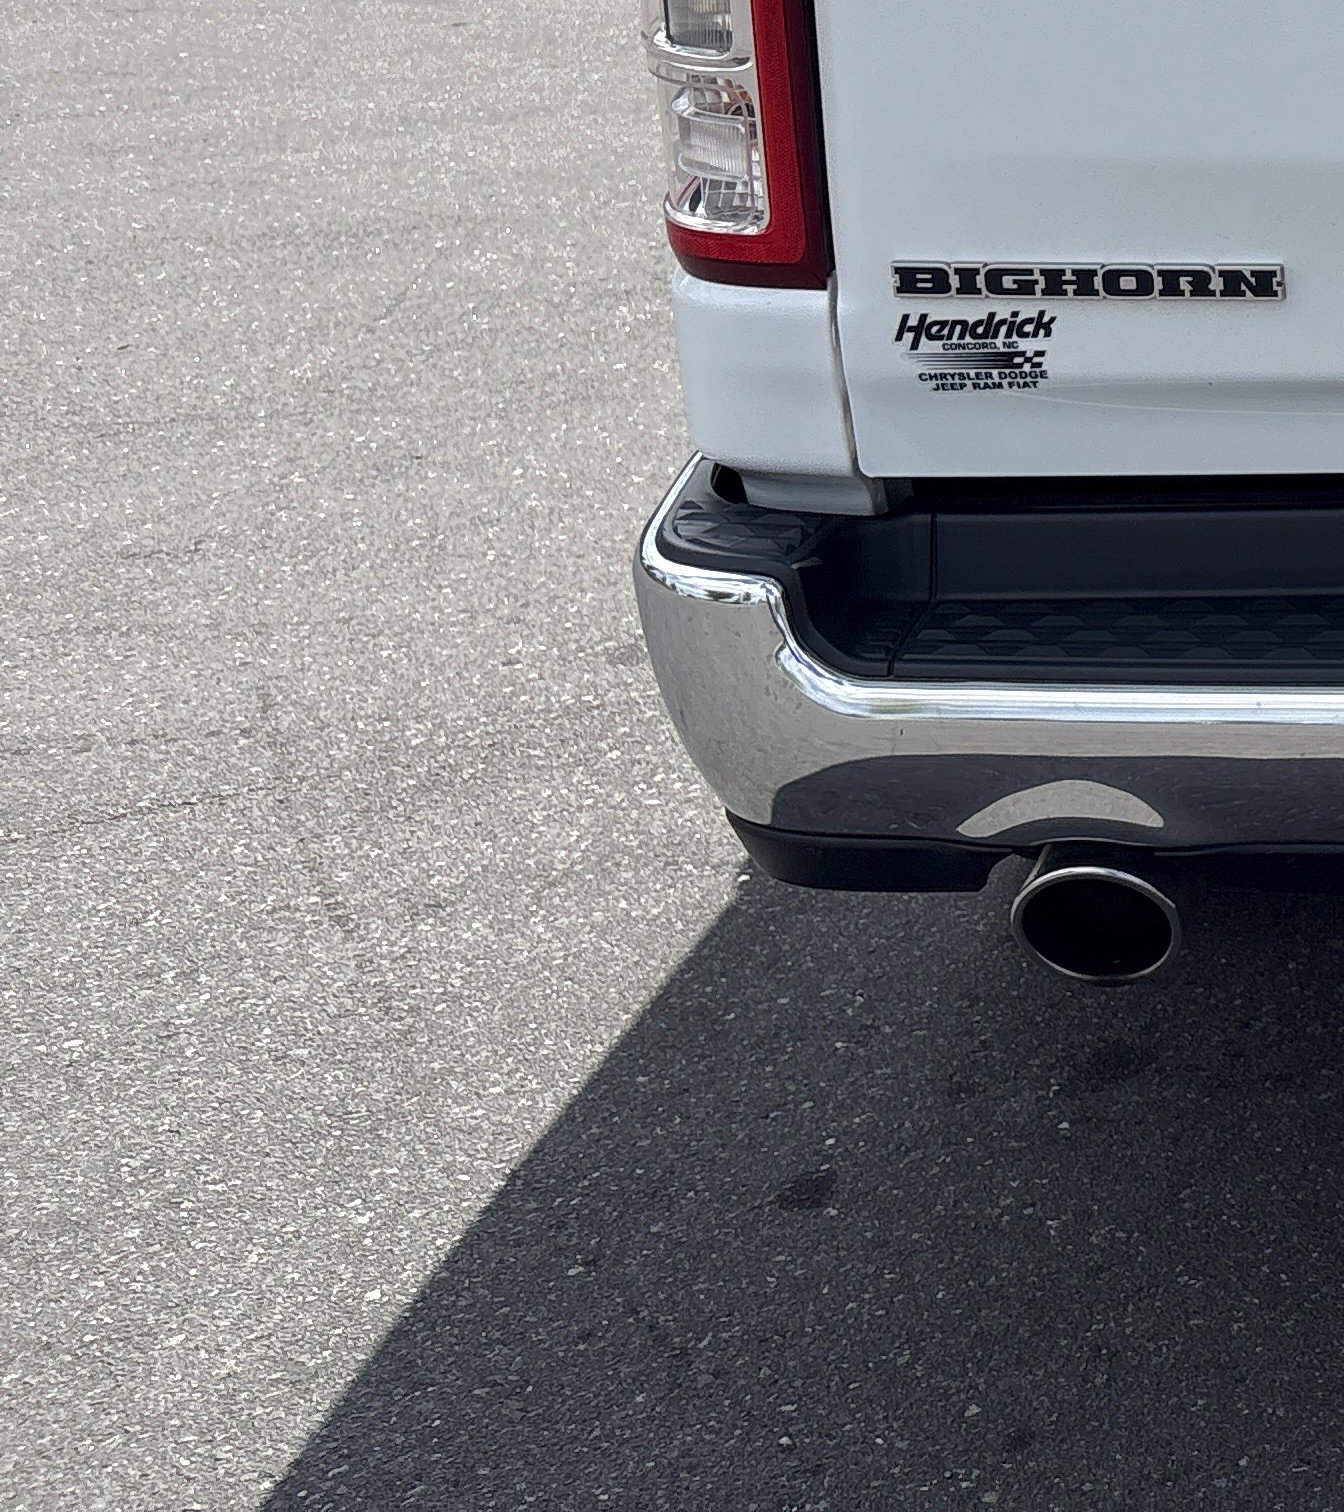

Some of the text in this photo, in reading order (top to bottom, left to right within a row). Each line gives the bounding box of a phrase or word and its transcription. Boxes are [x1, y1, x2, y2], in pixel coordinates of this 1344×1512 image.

[891, 262, 1284, 301] BIGHORN
[894, 309, 1058, 351] Hendrick
[941, 340, 1020, 351] CONCORD, NC
[918, 369, 1049, 382] CHRYSLER DODGE
[932, 380, 1040, 392] JEEP RAM FIAT
